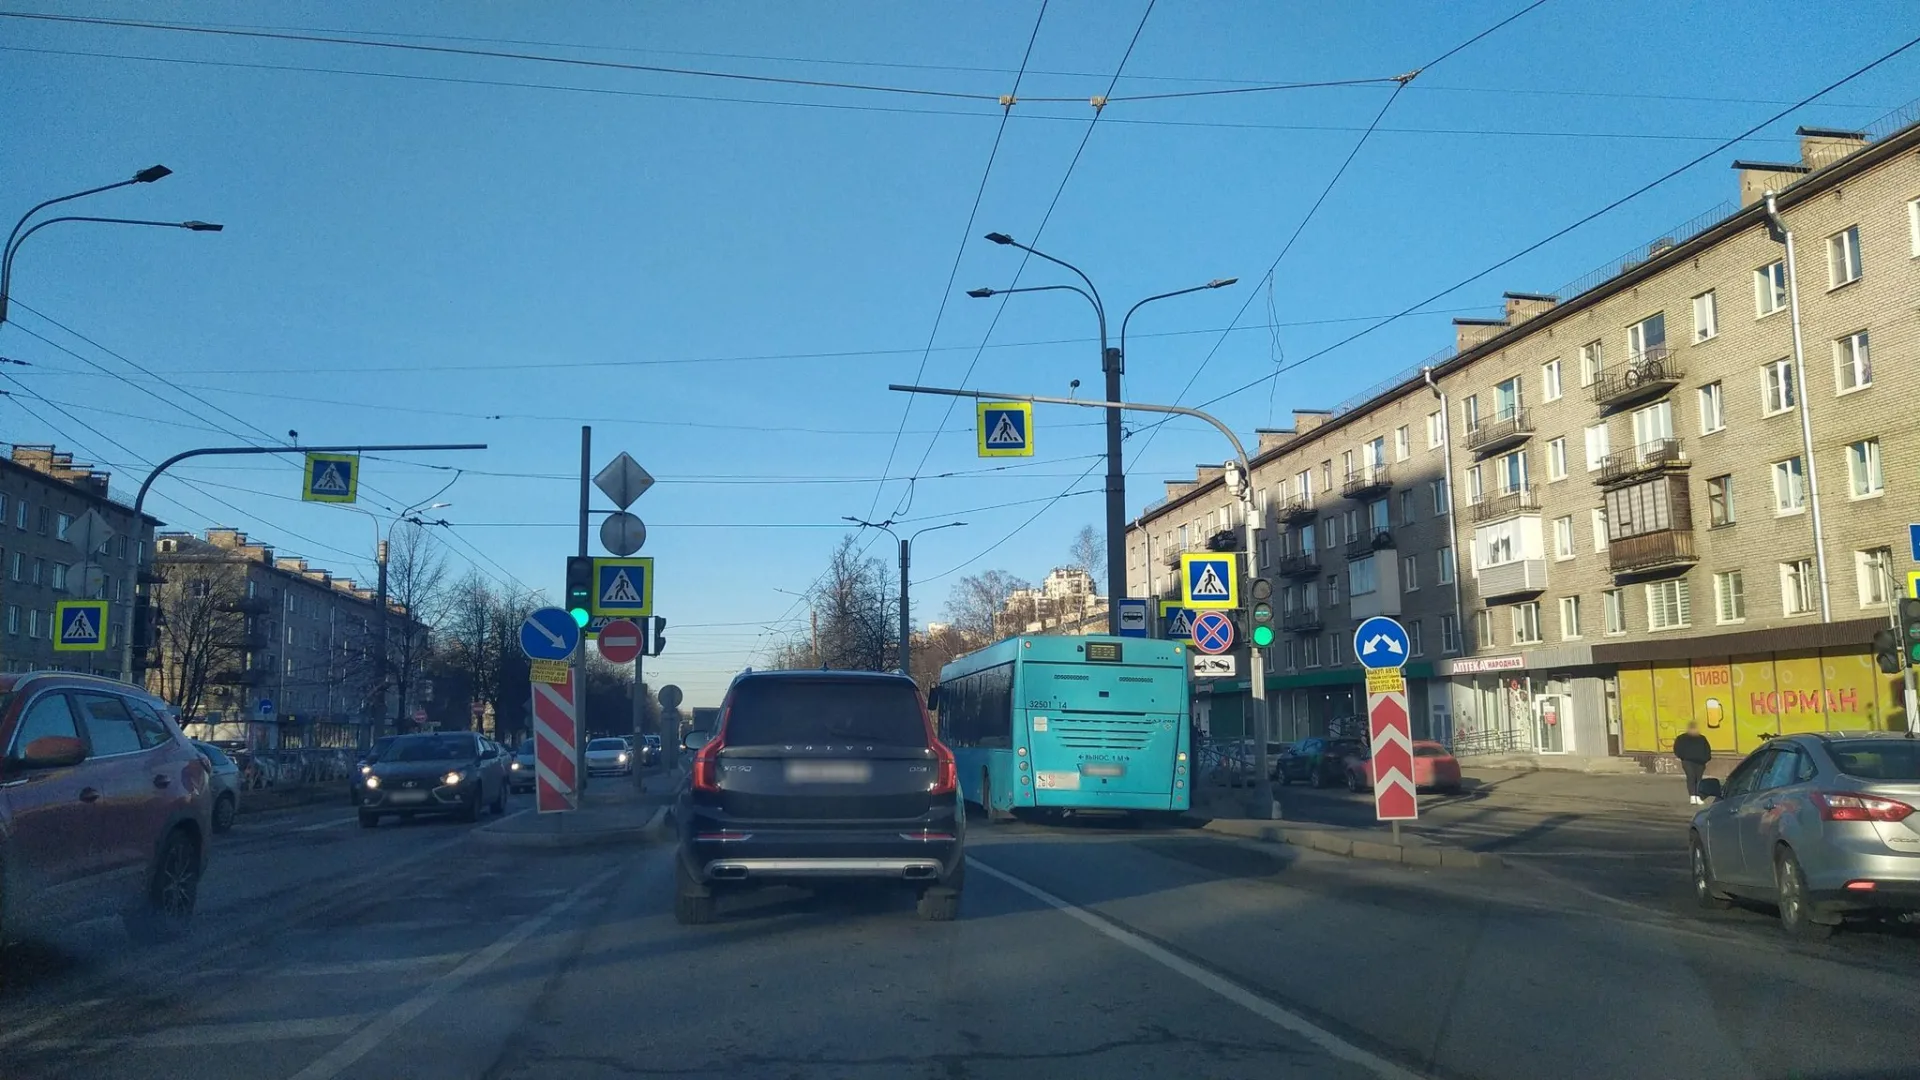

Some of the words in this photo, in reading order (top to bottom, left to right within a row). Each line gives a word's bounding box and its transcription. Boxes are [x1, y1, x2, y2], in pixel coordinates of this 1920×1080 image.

[1453, 660, 1486, 673] АПТЕКА
[1488, 659, 1520, 668] НАРОДНАЯ
[1694, 670, 1728, 686] ПИВО
[1029, 701, 1051, 709] 32501
[1750, 688, 1858, 715] НОРМАН
